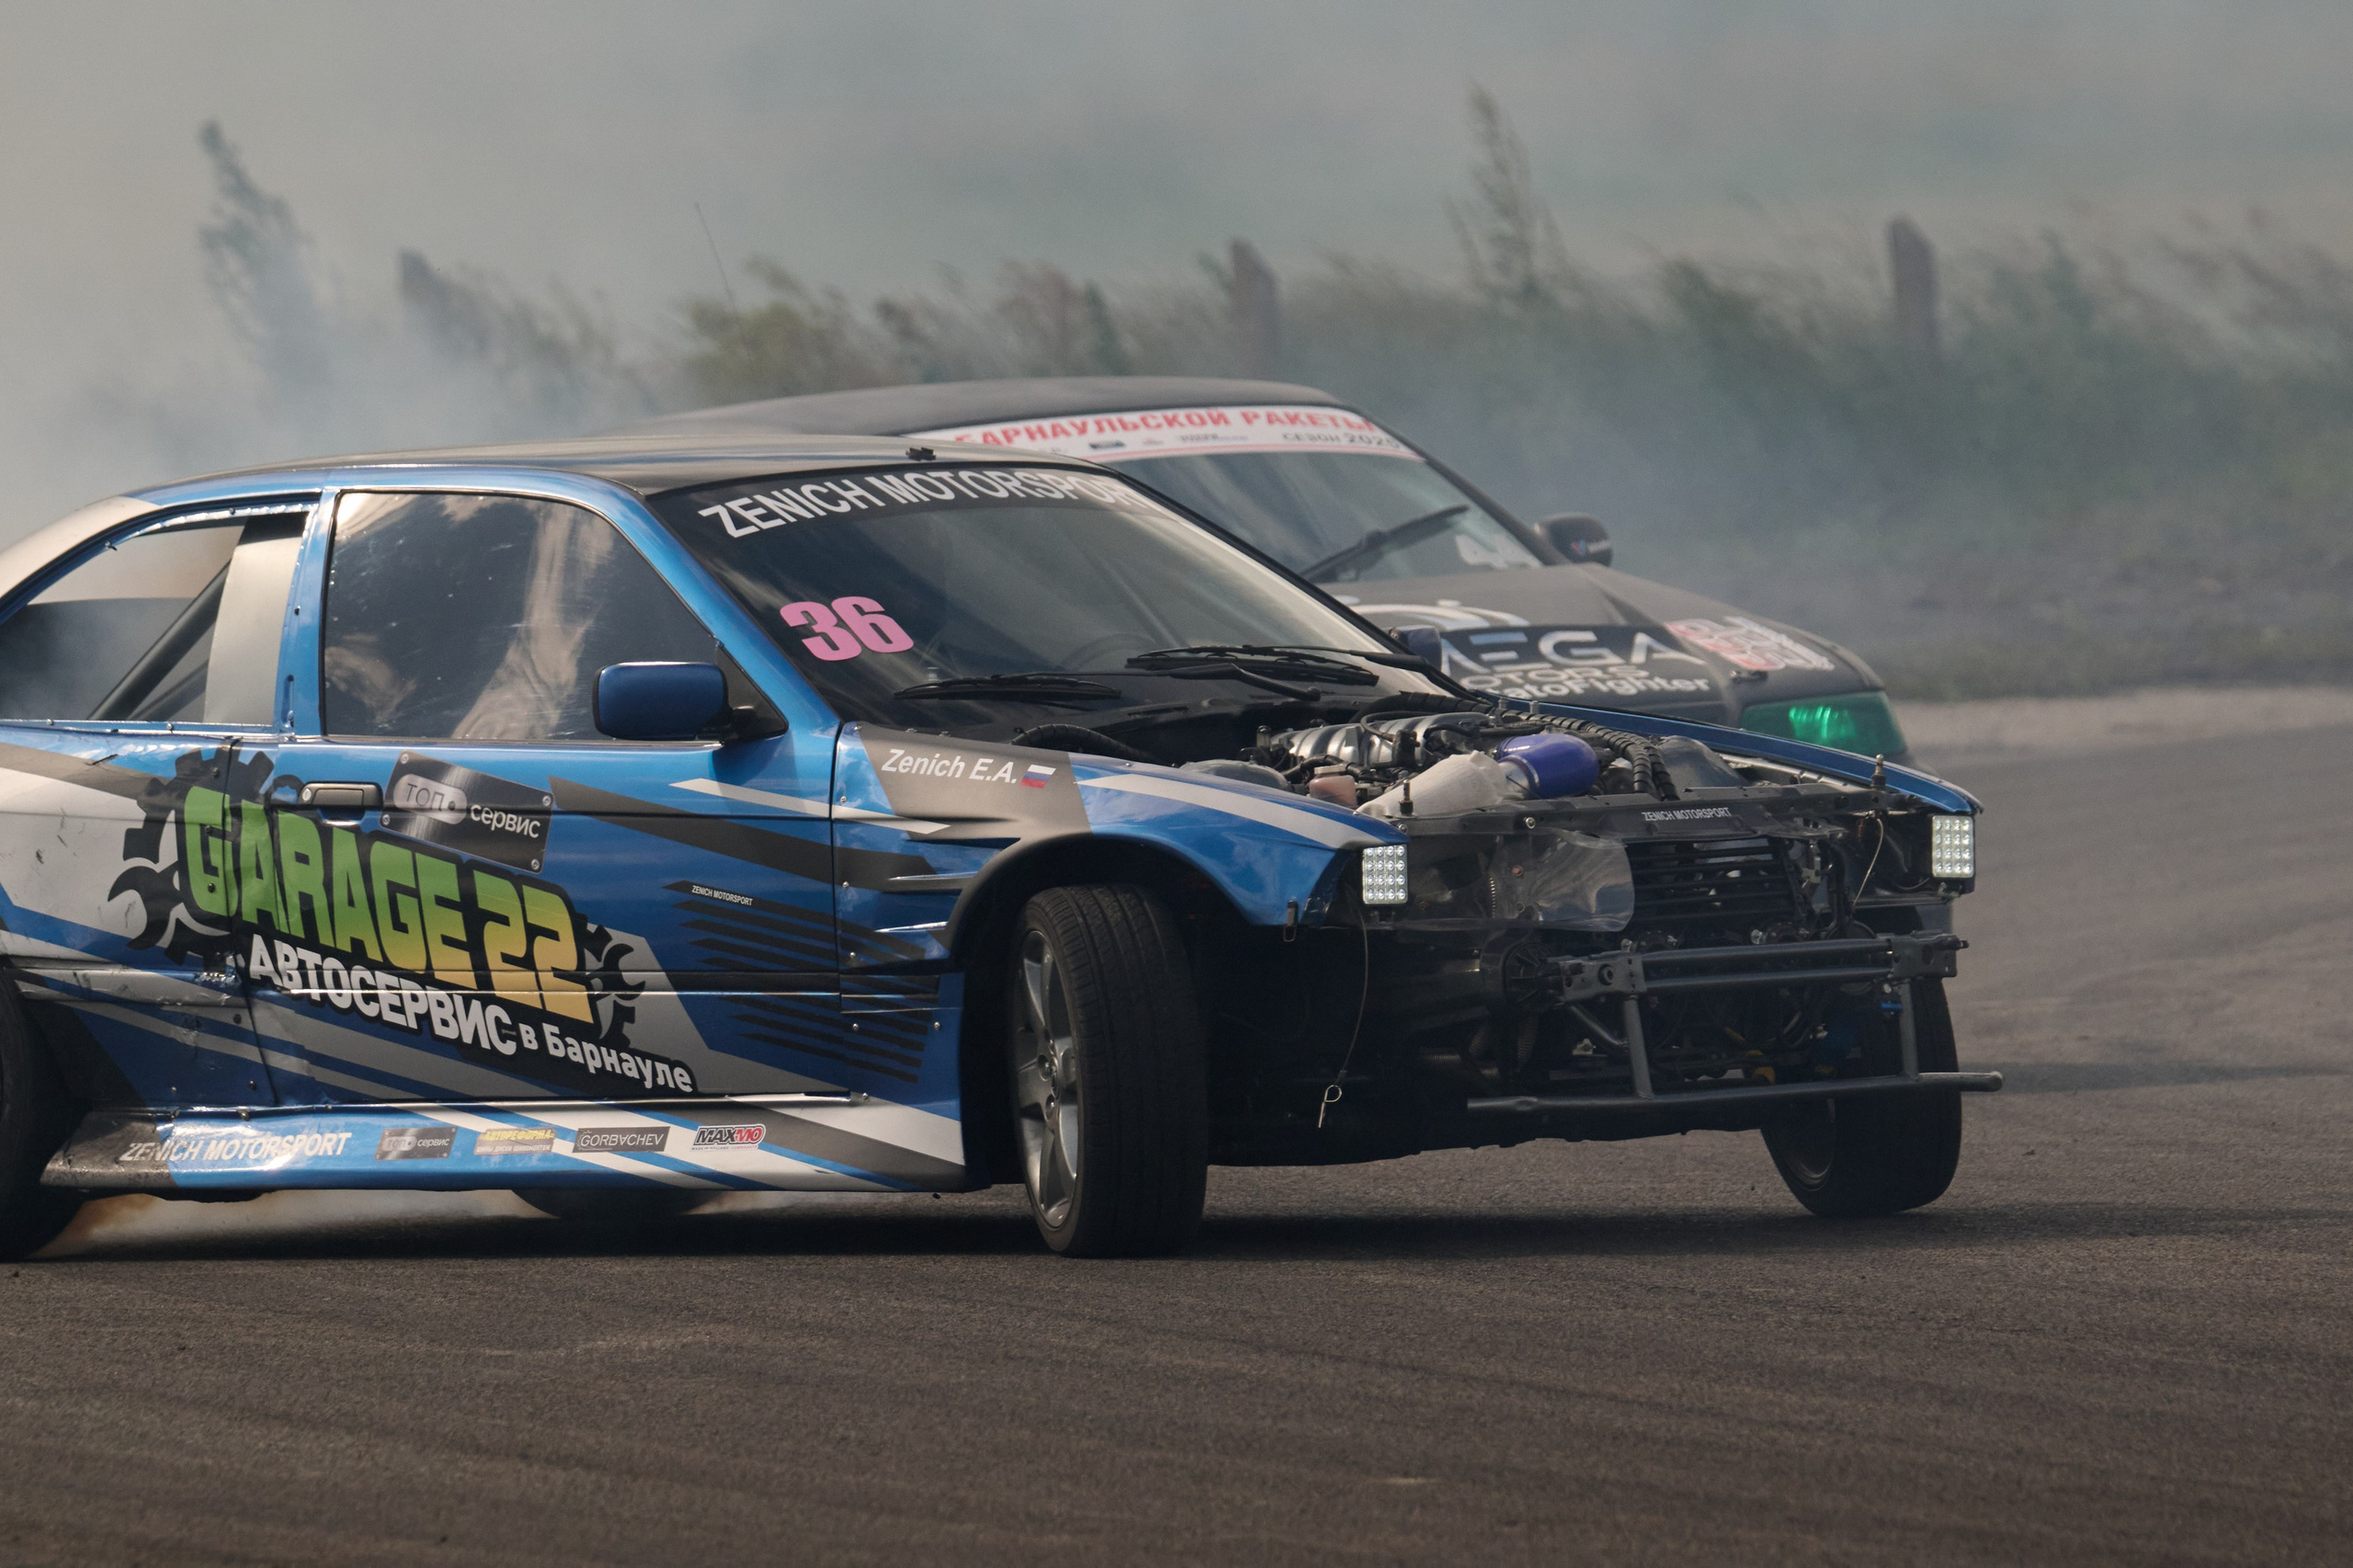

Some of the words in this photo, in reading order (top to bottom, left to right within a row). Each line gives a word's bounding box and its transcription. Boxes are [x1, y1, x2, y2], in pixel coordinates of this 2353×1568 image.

[1241, 411, 1377, 433] РАКЕТЫ
[698, 479, 886, 538] ZENICH
[779, 596, 915, 661] 36
[1461, 665, 1650, 688] OTORS
[881, 748, 965, 778] Zenich
[969, 757, 1017, 784] E.A.
[406, 783, 445, 812] ТОП
[470, 804, 541, 838] сервис
[1641, 810, 1676, 821] ZENICH
[1673, 807, 1732, 820] MOTORSPORT
[185, 786, 477, 990] GARAGE
[473, 869, 595, 1024] 22
[691, 884, 713, 897] ZENICH
[713, 890, 753, 905] MOTORSPORT
[249, 934, 519, 1055] АВТОСЕРВИС
[520, 1022, 539, 1051] в
[542, 1022, 694, 1093] Барнауле
[119, 1140, 203, 1162] ZENICH
[202, 1132, 353, 1161] MOTORSPORT
[417, 1138, 450, 1147] сервис
